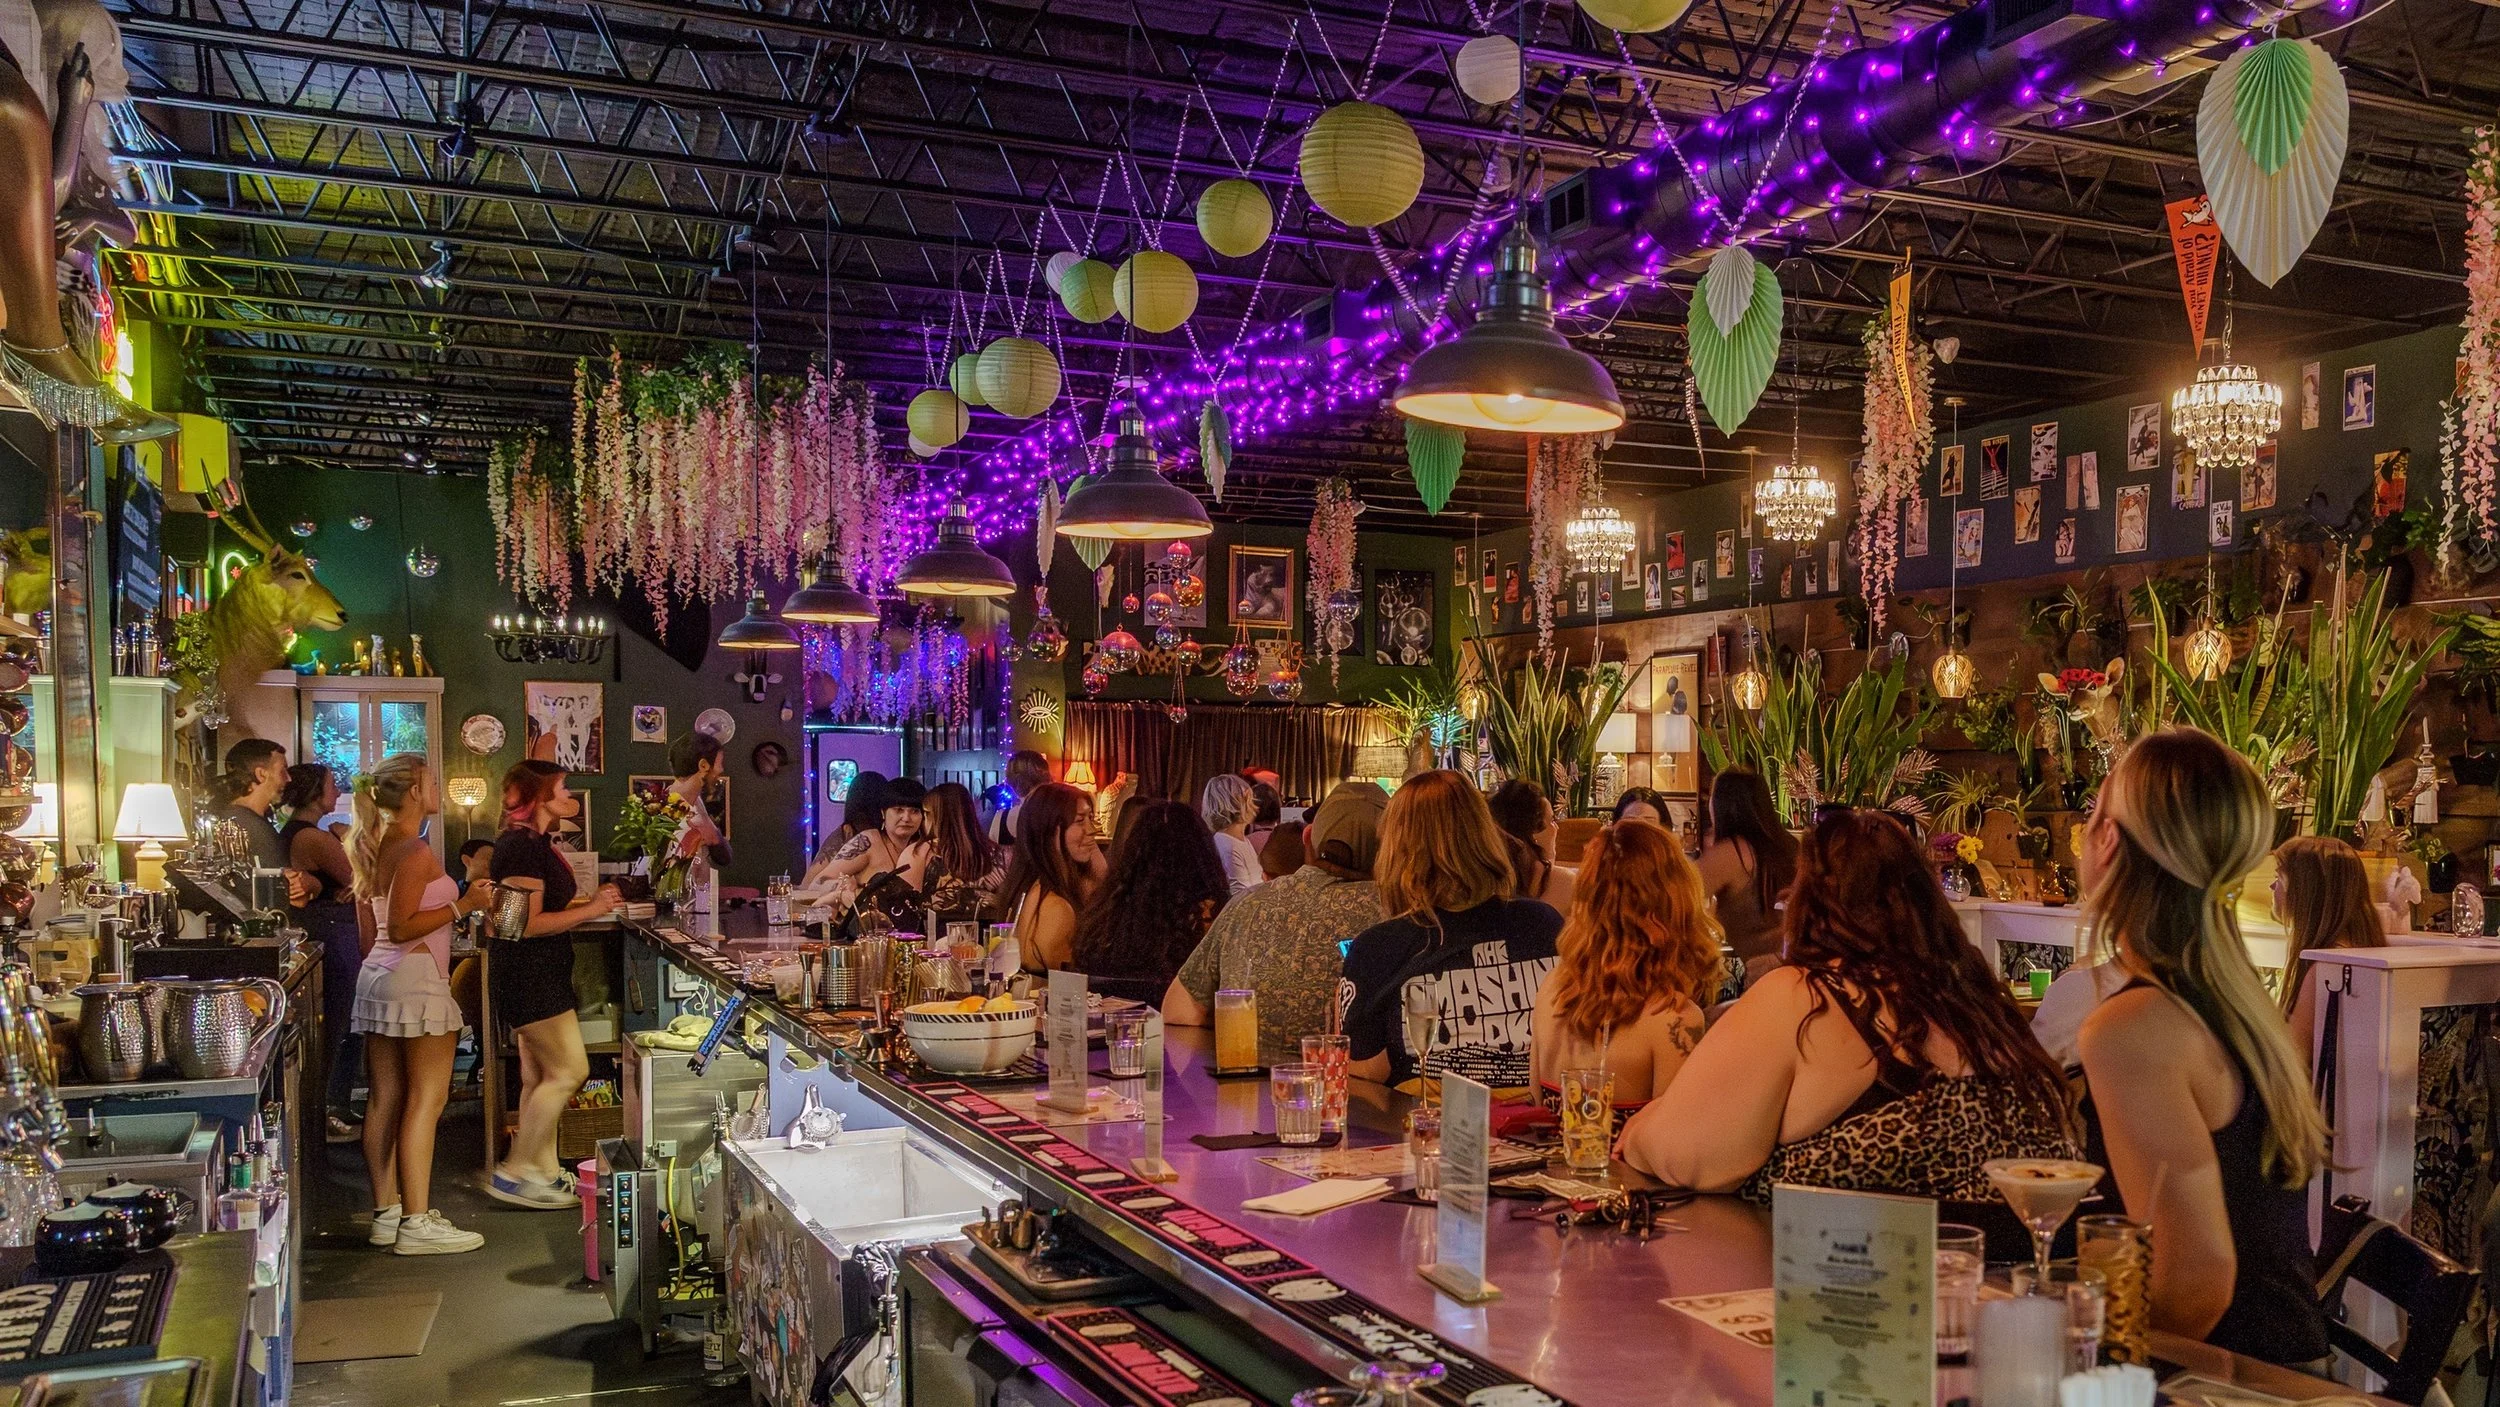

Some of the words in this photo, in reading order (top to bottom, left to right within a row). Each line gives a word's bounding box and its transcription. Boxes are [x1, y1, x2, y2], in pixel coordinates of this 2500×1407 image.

[2178, 237, 2194, 249] of
[2181, 250, 2195, 286] Afraid
[1472, 940, 1509, 967] THE
[1401, 956, 1560, 1023] SMASHIN
